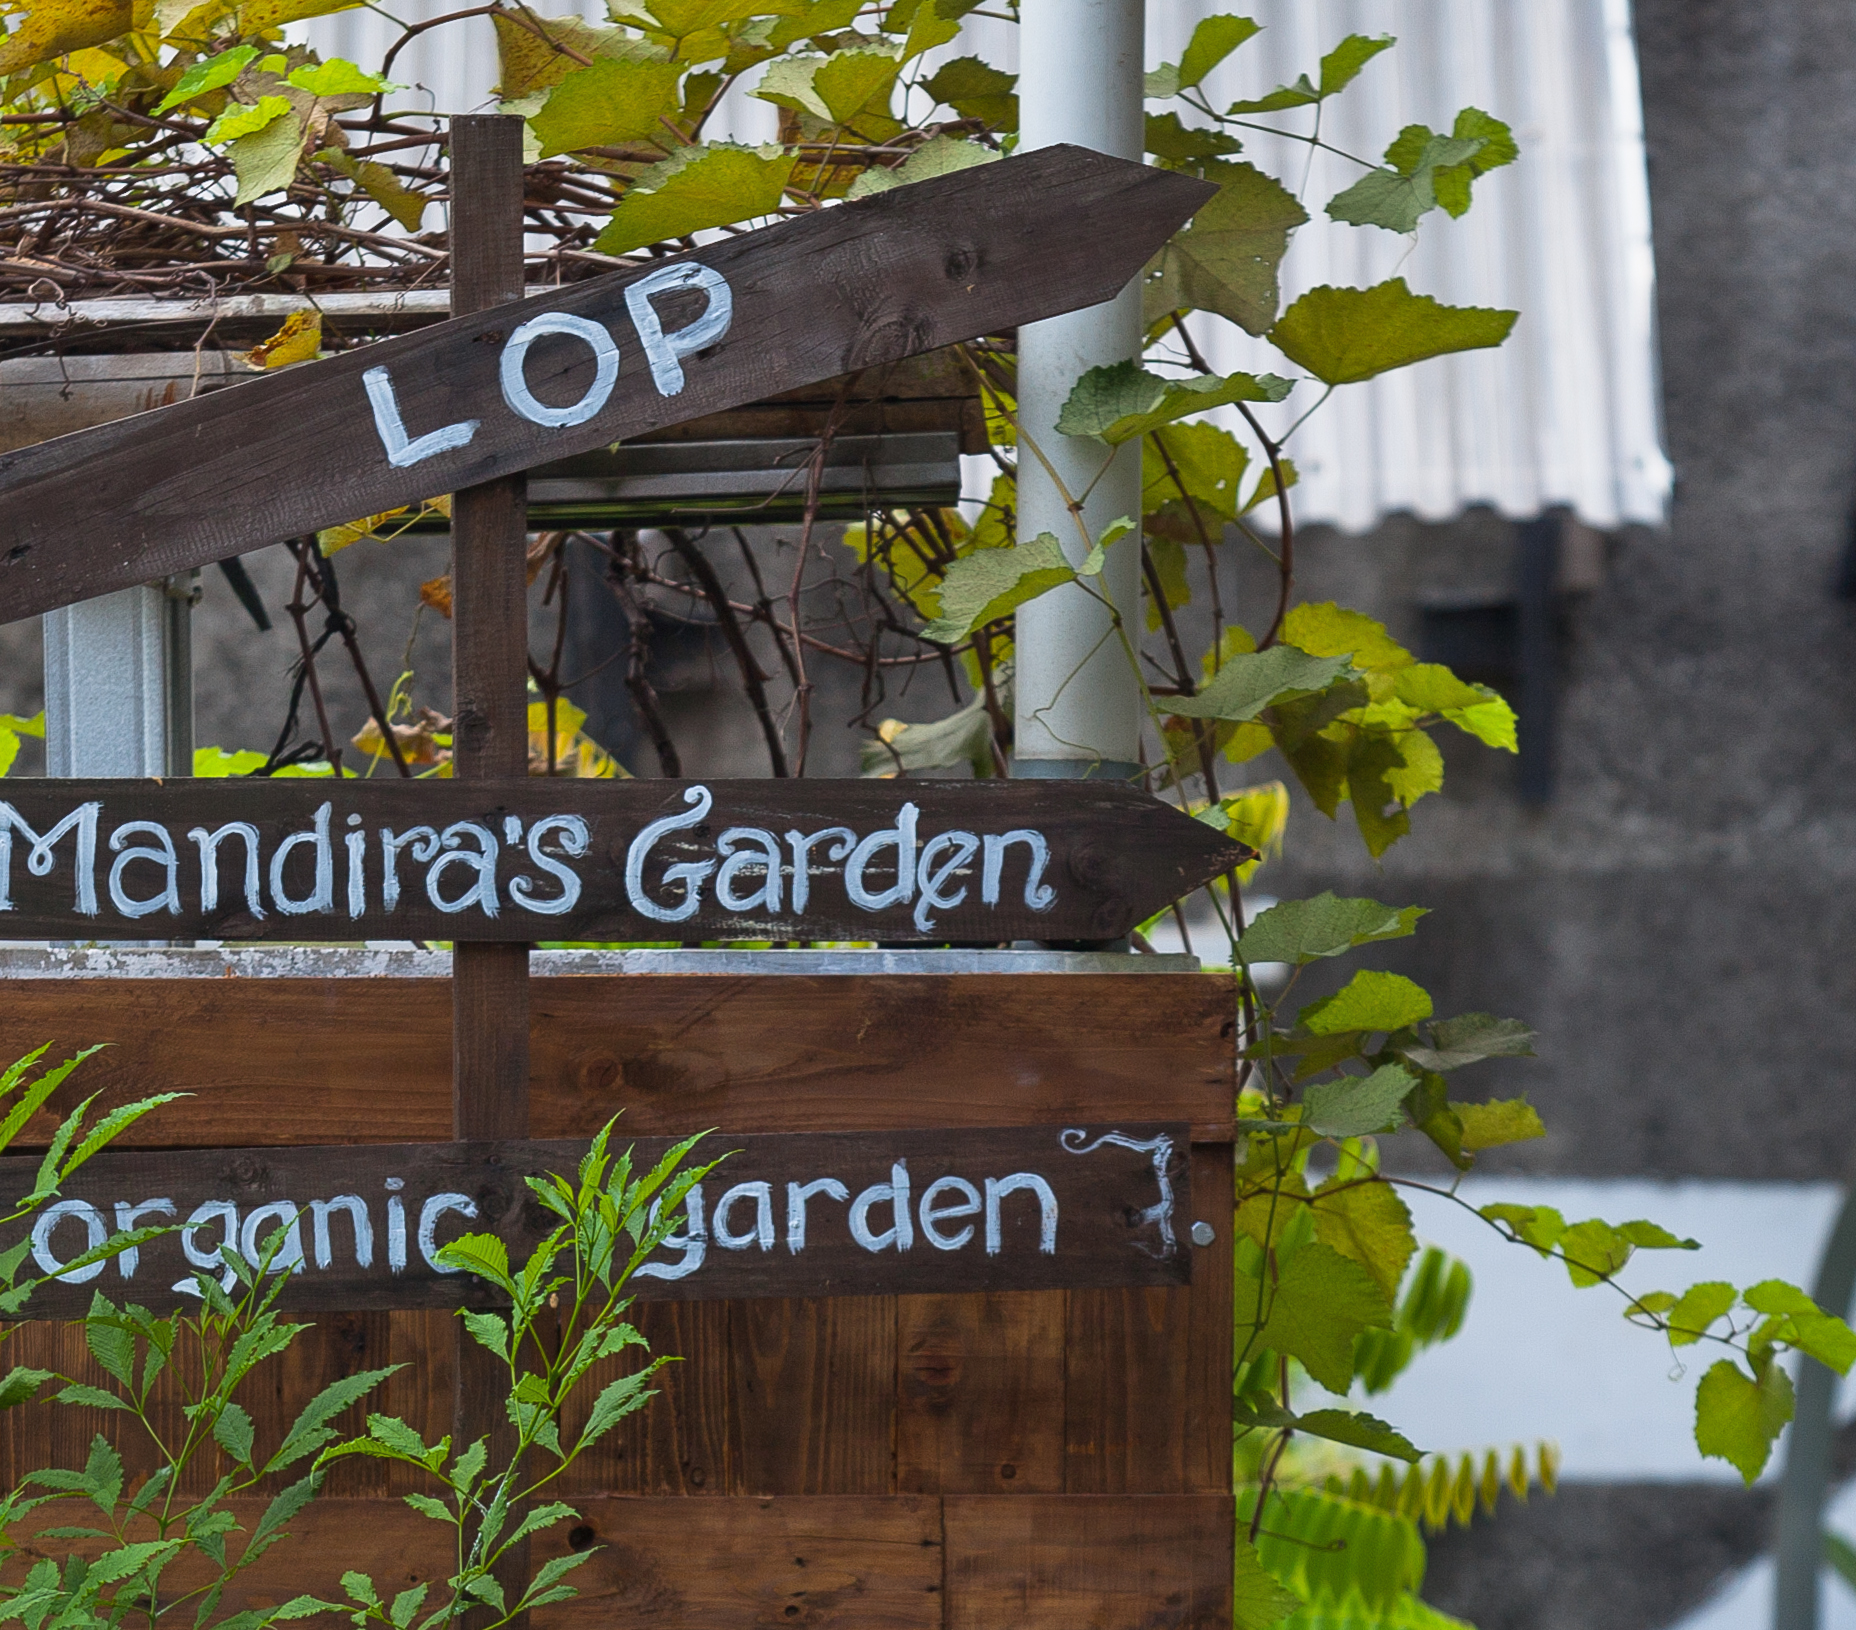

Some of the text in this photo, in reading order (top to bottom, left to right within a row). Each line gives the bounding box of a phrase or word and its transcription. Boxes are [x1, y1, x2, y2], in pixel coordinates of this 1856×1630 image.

[364, 260, 734, 469] LOP
[624, 785, 1058, 934] Garden
[30, 1157, 1059, 1298] organic garden
